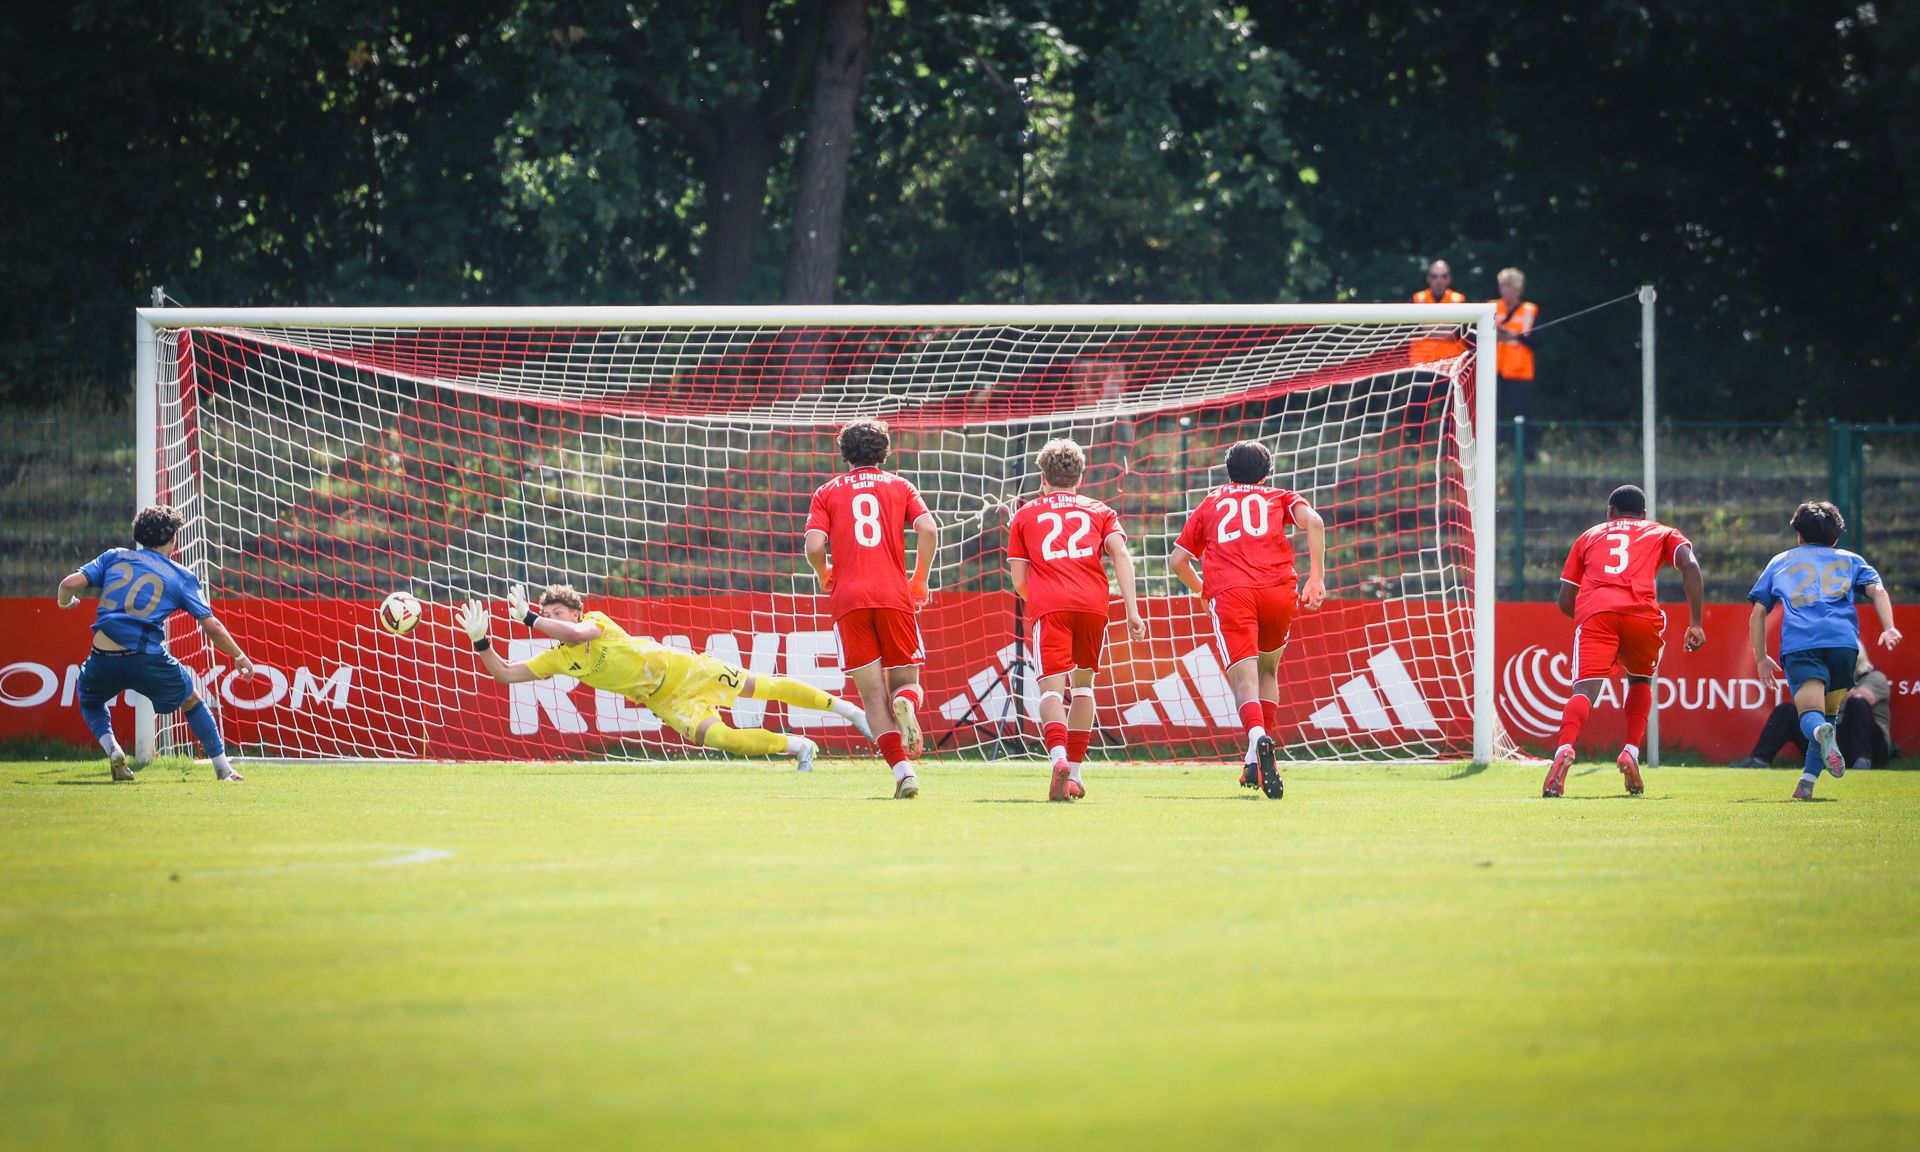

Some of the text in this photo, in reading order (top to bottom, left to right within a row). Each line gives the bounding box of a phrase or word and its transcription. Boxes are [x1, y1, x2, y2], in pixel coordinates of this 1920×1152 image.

[844, 475, 857, 484] FC
[859, 473, 892, 484] UNION
[852, 480, 875, 490] BERLIN
[852, 493, 882, 547] 8
[1037, 510, 1094, 562] 22
[1215, 493, 1269, 544] 20
[1604, 533, 1630, 575] 3
[98, 561, 165, 619] 20
[1787, 559, 1851, 609] 26
[718, 665, 744, 689] 24
